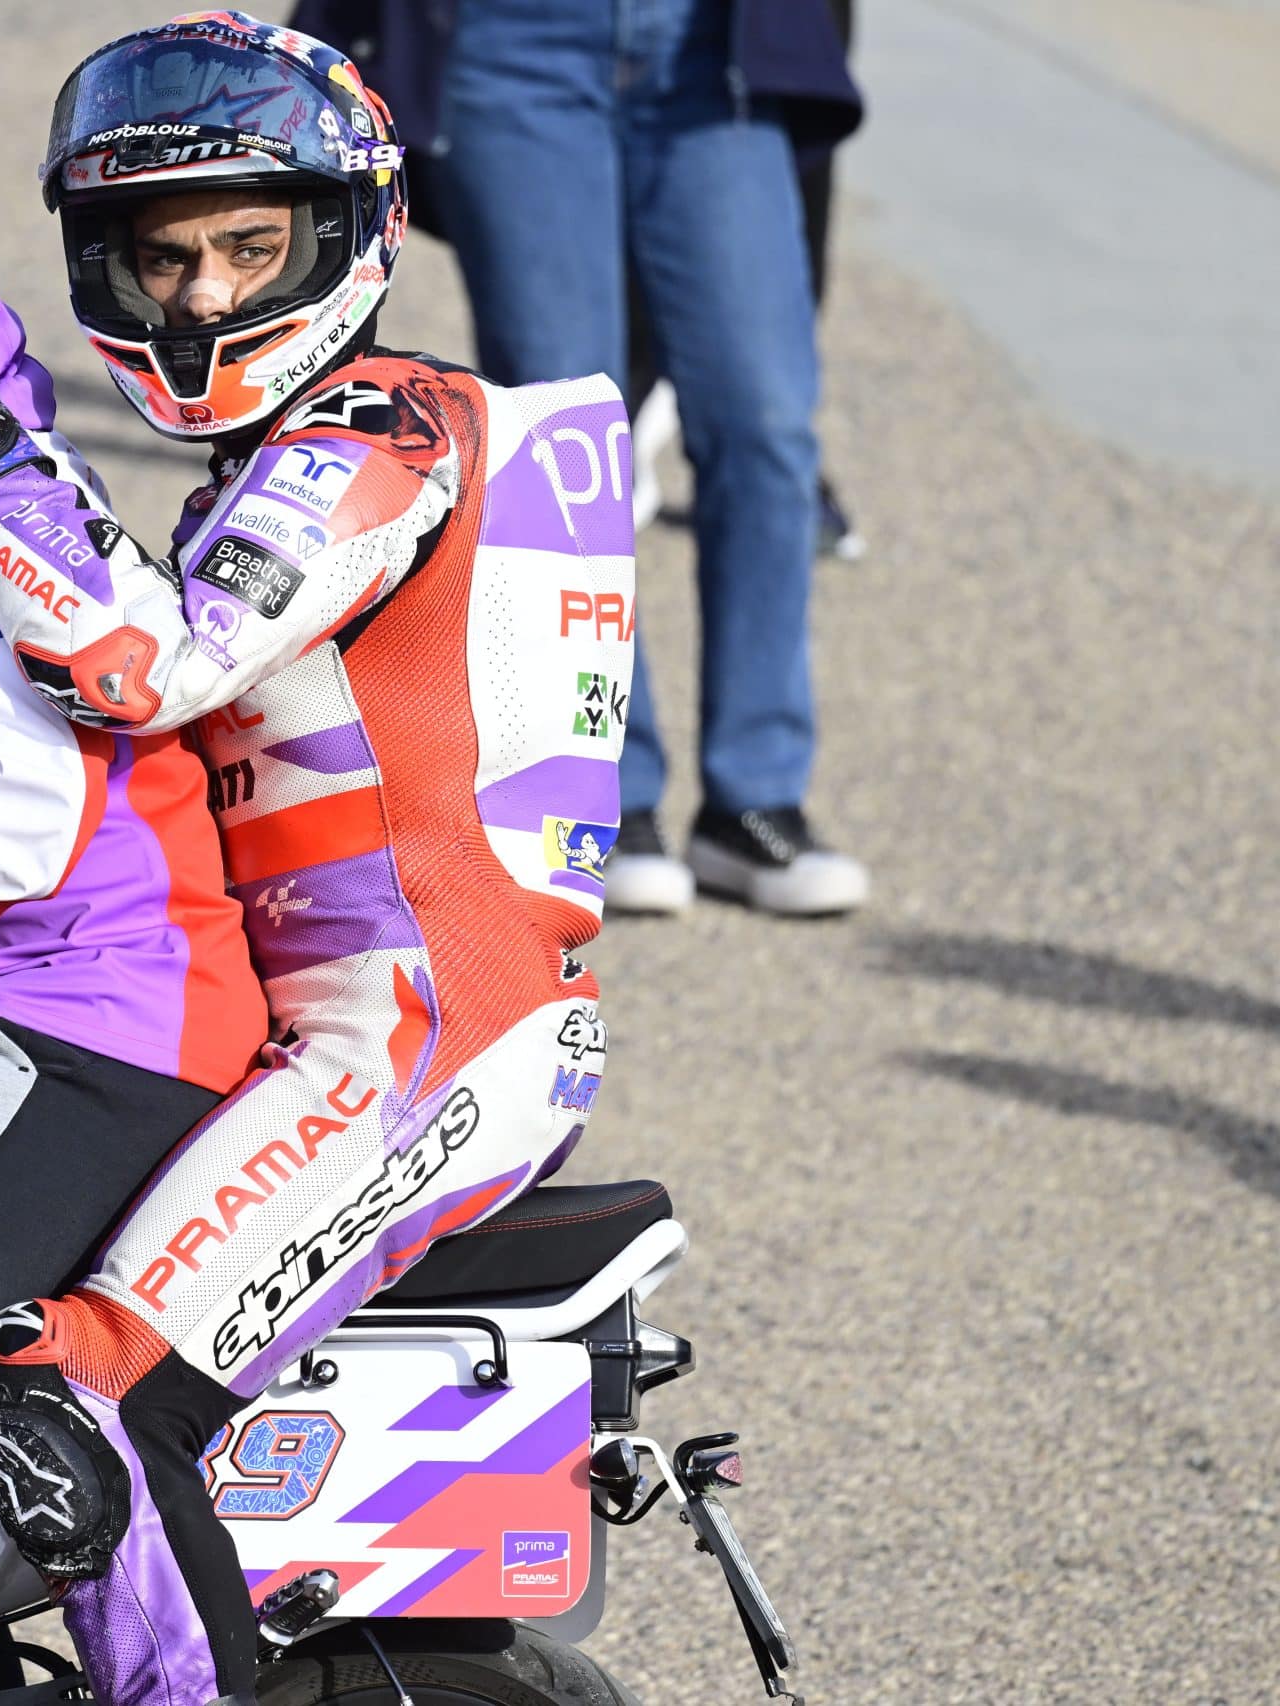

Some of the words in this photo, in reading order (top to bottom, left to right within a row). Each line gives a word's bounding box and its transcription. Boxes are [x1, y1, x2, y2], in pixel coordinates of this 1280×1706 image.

[88, 123, 201, 146] MOTOBLOUZ
[237, 133, 292, 151] MOTOBLOUZ
[343, 144, 403, 172] 89
[287, 317, 350, 382] kyrrex
[175, 418, 231, 433] PRAMAC
[269, 477, 334, 511] randstad
[0, 500, 95, 567] prima
[231, 511, 290, 542] wallife
[216, 541, 291, 592] Breathe
[231, 567, 282, 611] Right
[130, 1073, 379, 1313] PRAMAC
[214, 1086, 480, 1370] alpinestars
[514, 1541, 555, 1555] prima
[512, 1573, 559, 1582] PRAMAC
